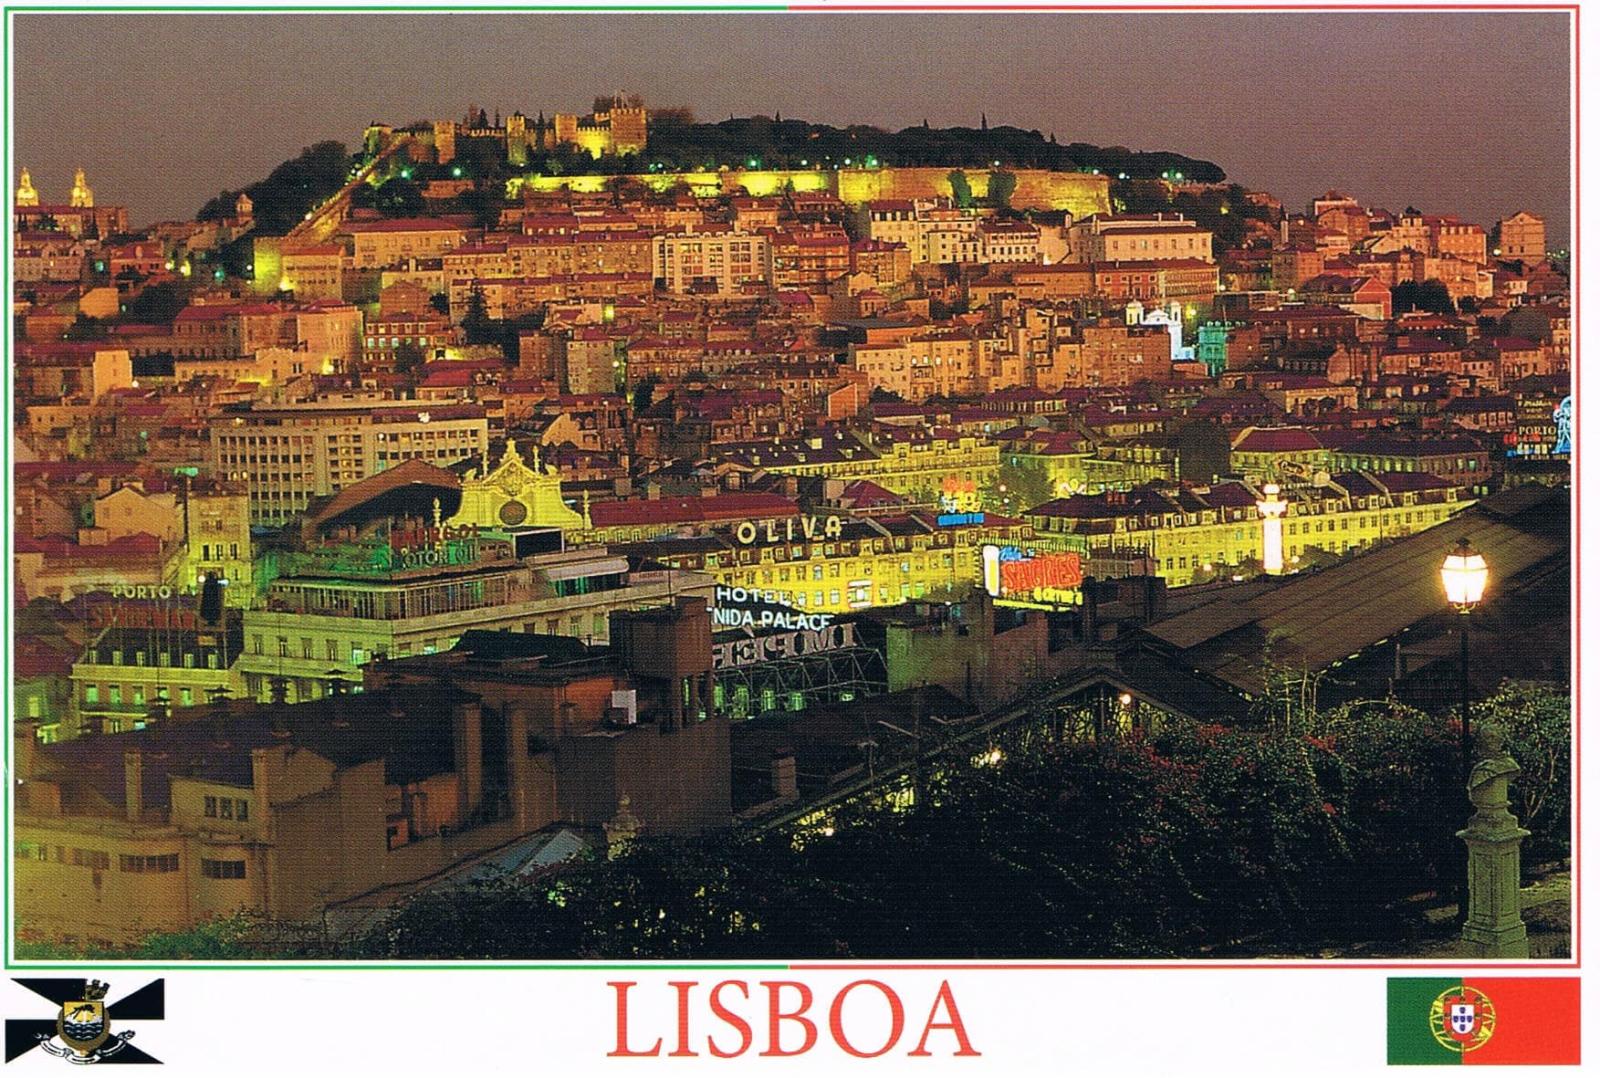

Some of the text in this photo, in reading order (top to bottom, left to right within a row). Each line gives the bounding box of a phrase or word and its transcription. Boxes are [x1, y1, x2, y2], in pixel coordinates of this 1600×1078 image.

[737, 514, 842, 544] OLIVA
[111, 584, 170, 599] PORTO
[716, 586, 792, 607] HOTEL
[707, 607, 754, 627] NIDA
